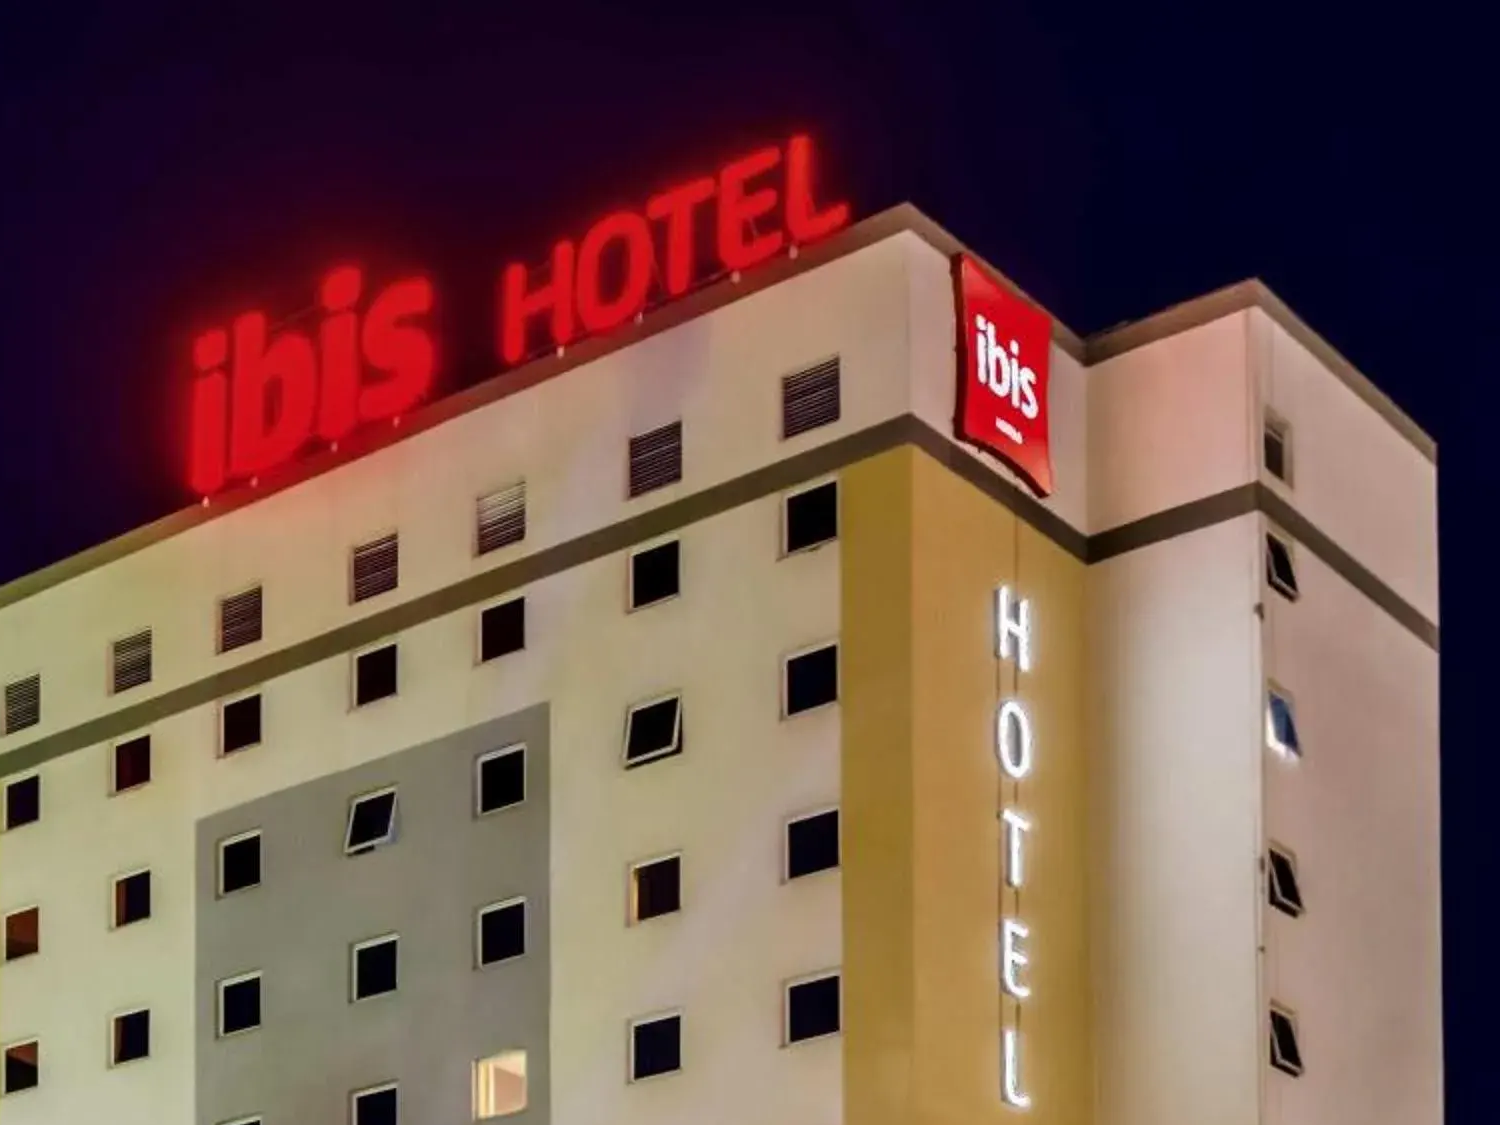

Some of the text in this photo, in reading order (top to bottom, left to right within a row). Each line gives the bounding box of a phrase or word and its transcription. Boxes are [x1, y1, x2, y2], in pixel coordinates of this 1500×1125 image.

[191, 134, 848, 495] ibis HOTEL
[975, 313, 1039, 420] ibis
[997, 585, 1032, 1108] HOTEL
